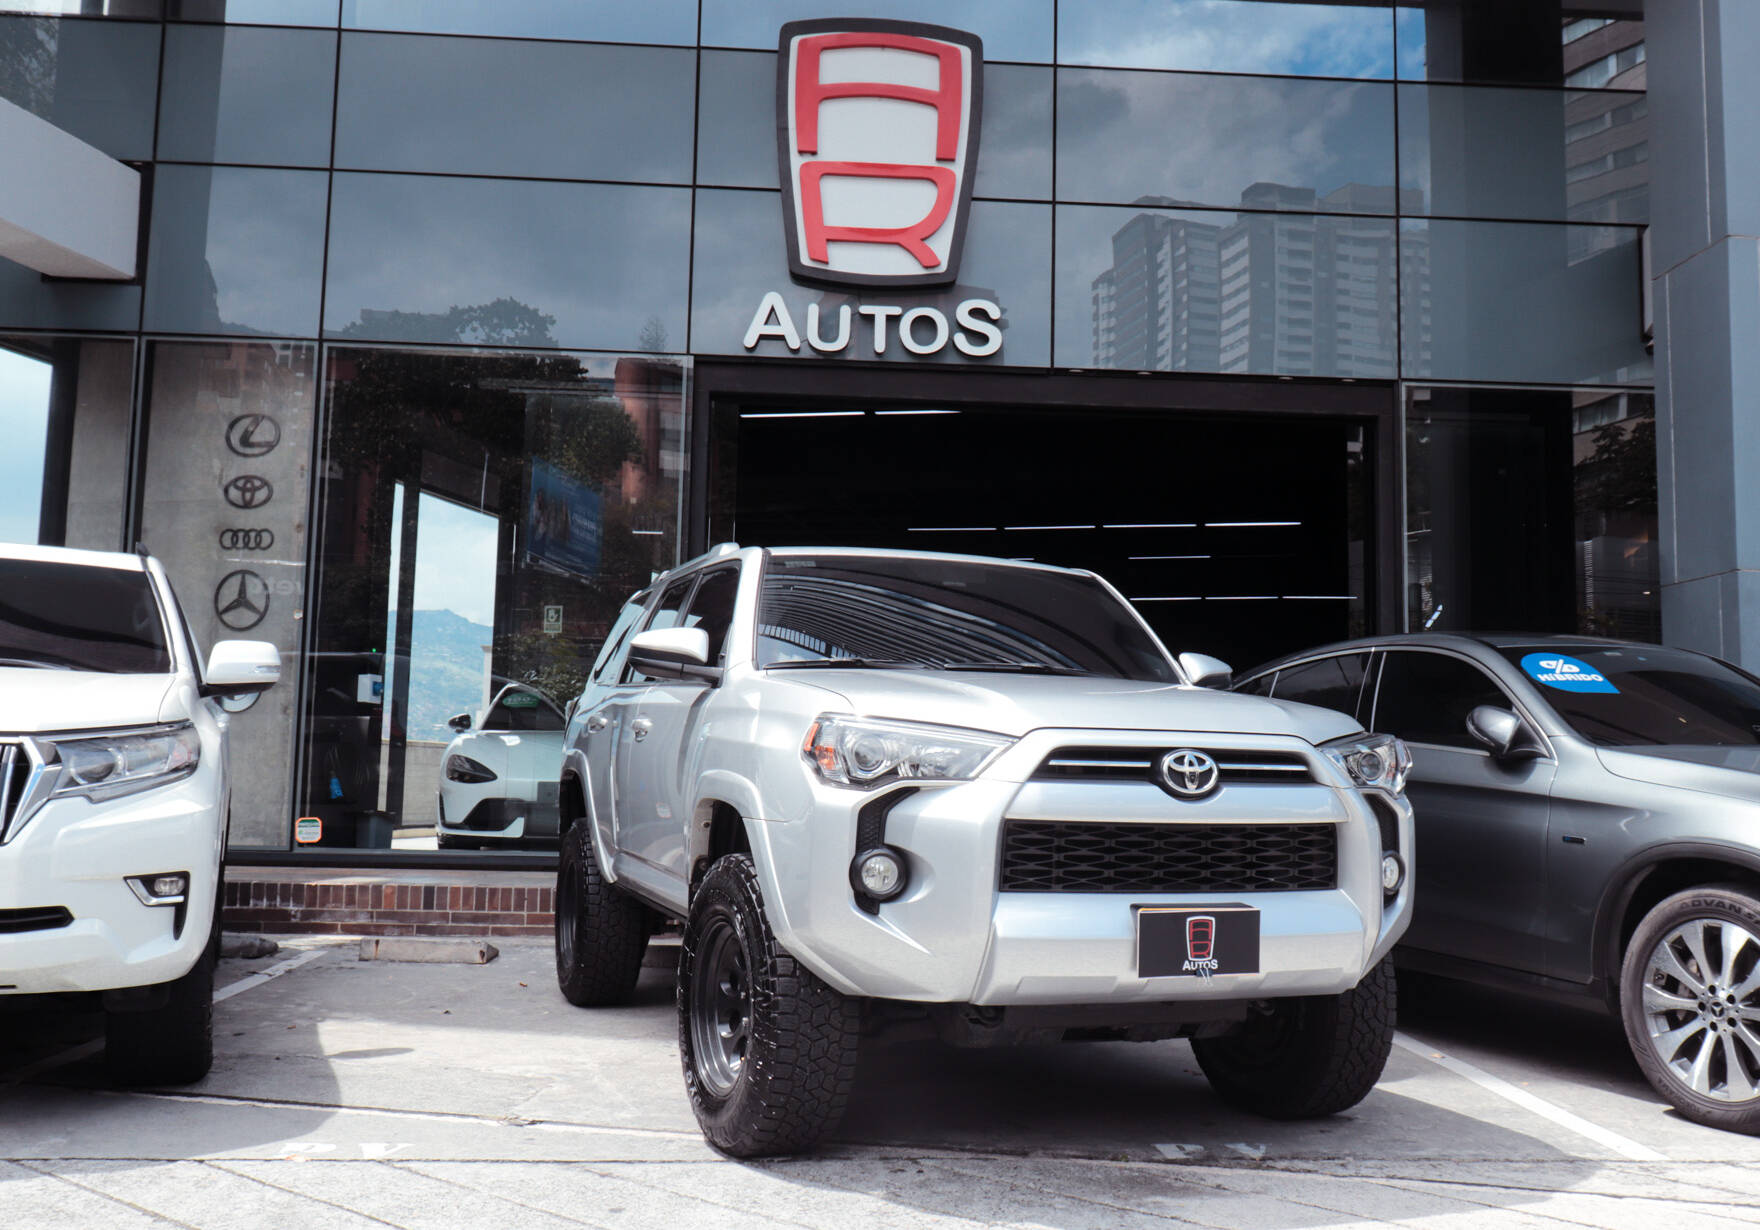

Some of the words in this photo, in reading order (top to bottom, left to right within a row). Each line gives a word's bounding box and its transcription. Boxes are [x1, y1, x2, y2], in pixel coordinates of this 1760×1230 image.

[743, 291, 1003, 357] AUTOS
[1680, 899, 1742, 914] ADVAN
[1182, 959, 1218, 971] AUTOS
